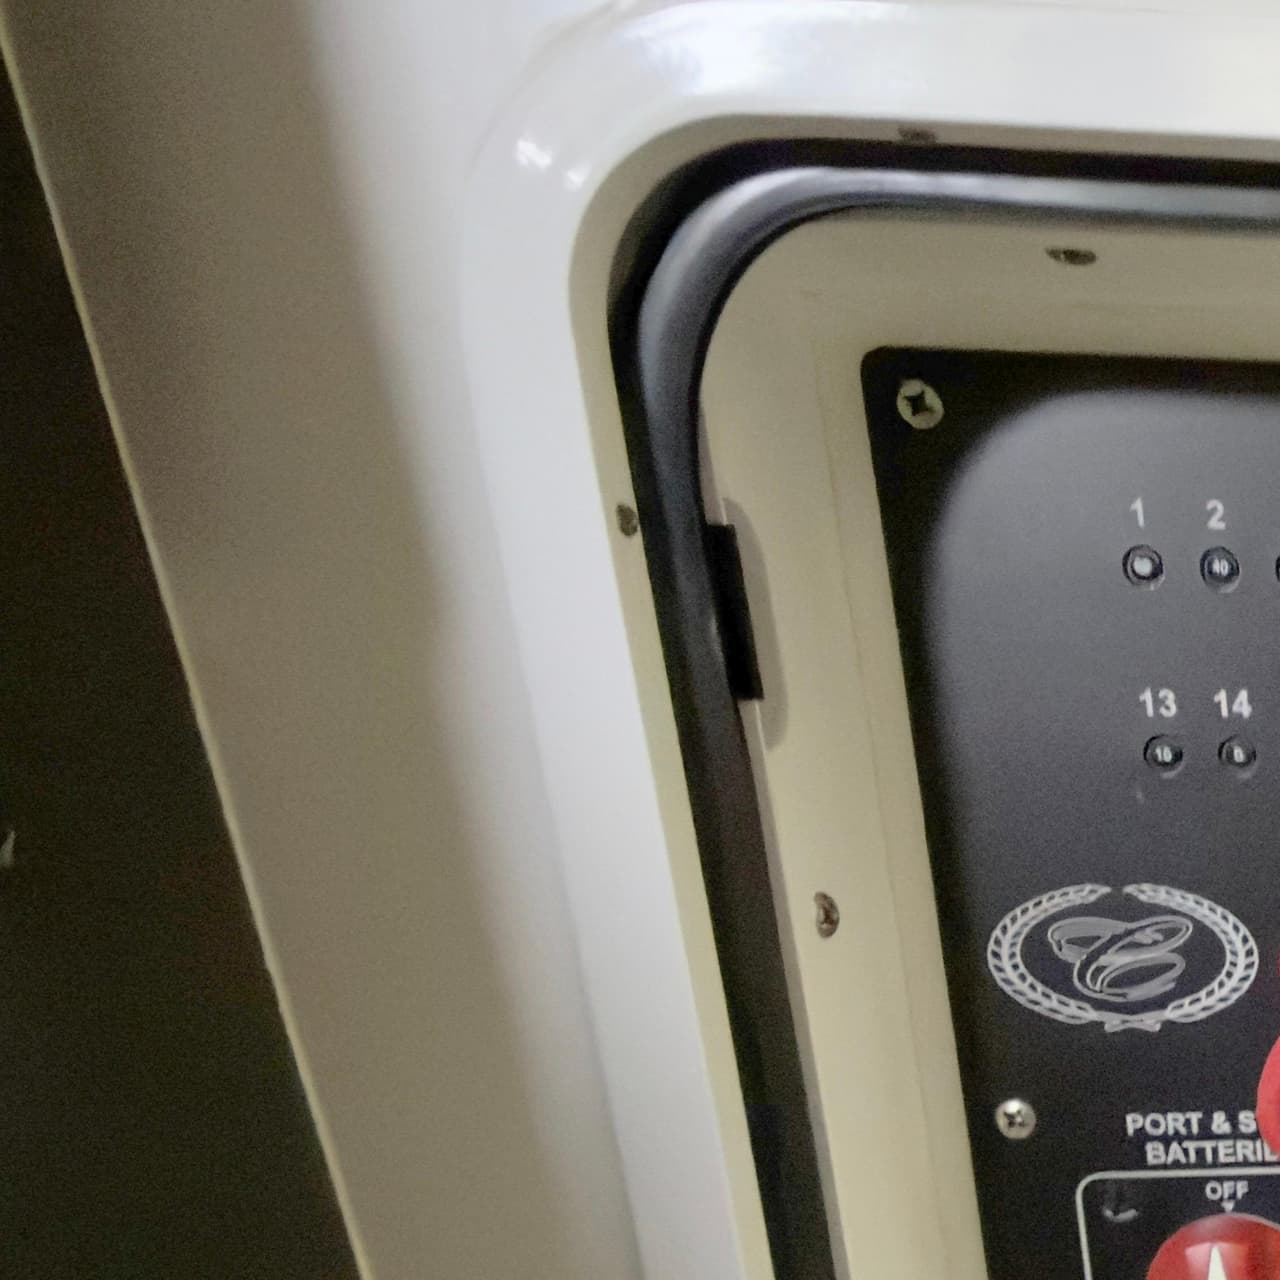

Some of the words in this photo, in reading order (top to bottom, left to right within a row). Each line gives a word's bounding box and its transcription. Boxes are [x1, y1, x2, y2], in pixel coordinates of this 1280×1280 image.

[1130, 497, 1145, 528] 1
[1206, 499, 1226, 530] 2
[1139, 687, 1177, 717] 13
[1214, 688, 1252, 718] 14
[1125, 1112, 1203, 1137] PORT
[1211, 1111, 1231, 1133] &
[1205, 1181, 1249, 1200] OFF
